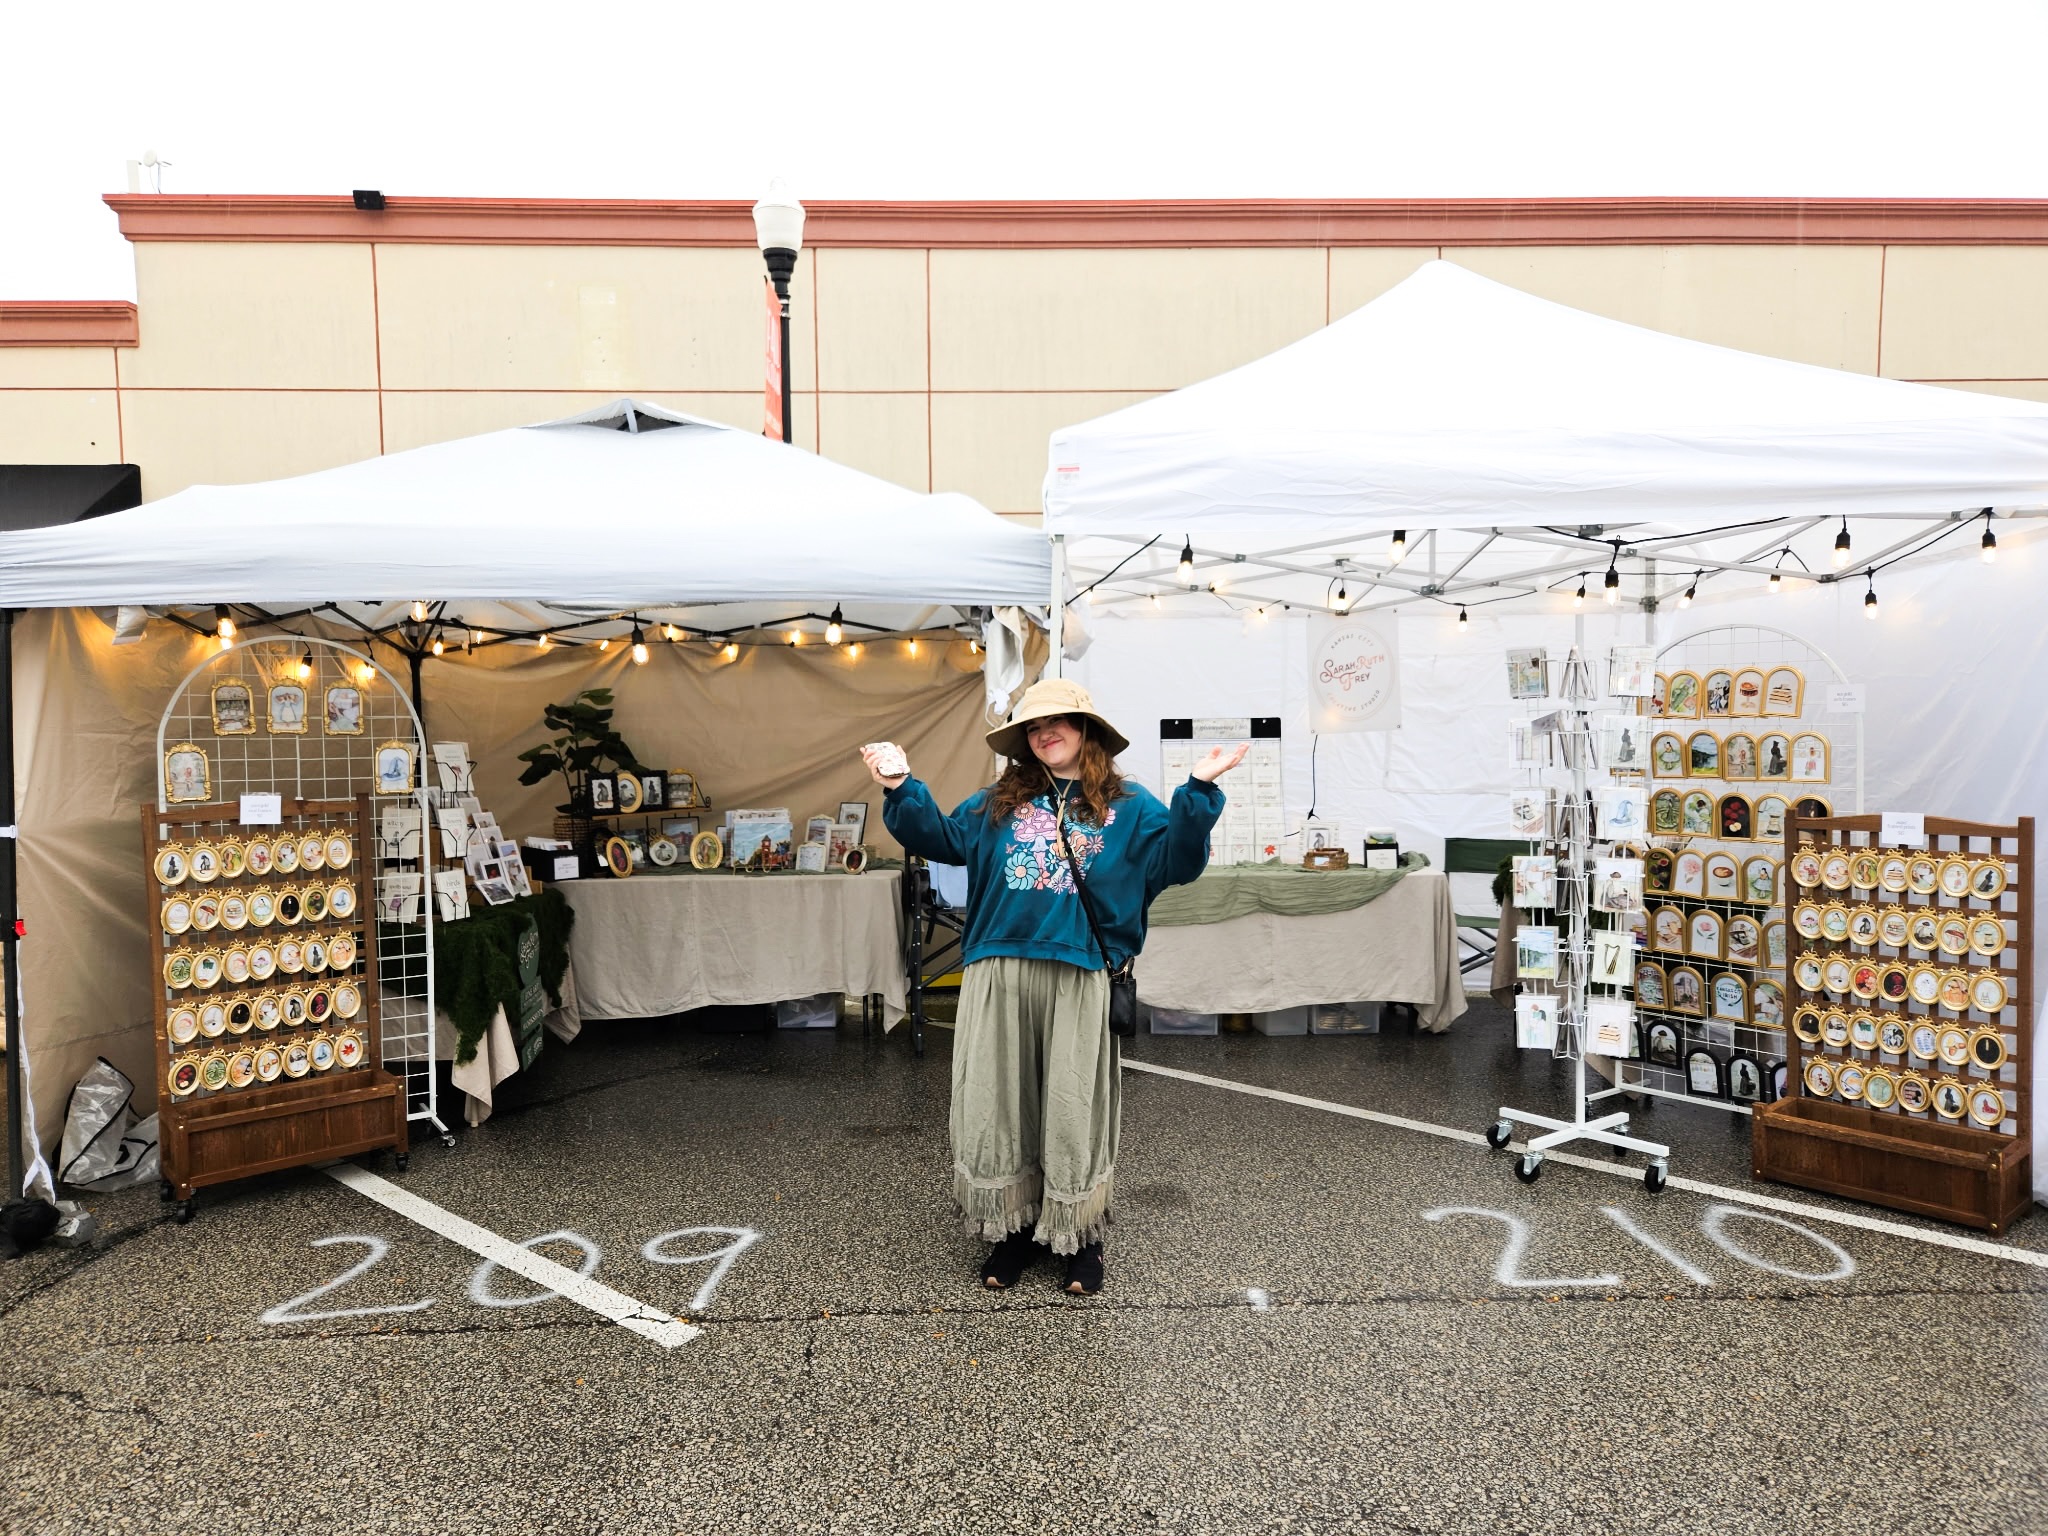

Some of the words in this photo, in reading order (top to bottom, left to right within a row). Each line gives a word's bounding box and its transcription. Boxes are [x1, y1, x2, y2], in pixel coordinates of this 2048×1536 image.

[1330, 633, 1355, 649] KANSAS
[1357, 634, 1375, 647] CITY
[1360, 689, 1381, 711] STUDIO
[1421, 1203, 1856, 1289] 210
[259, 1225, 765, 1324] 209
